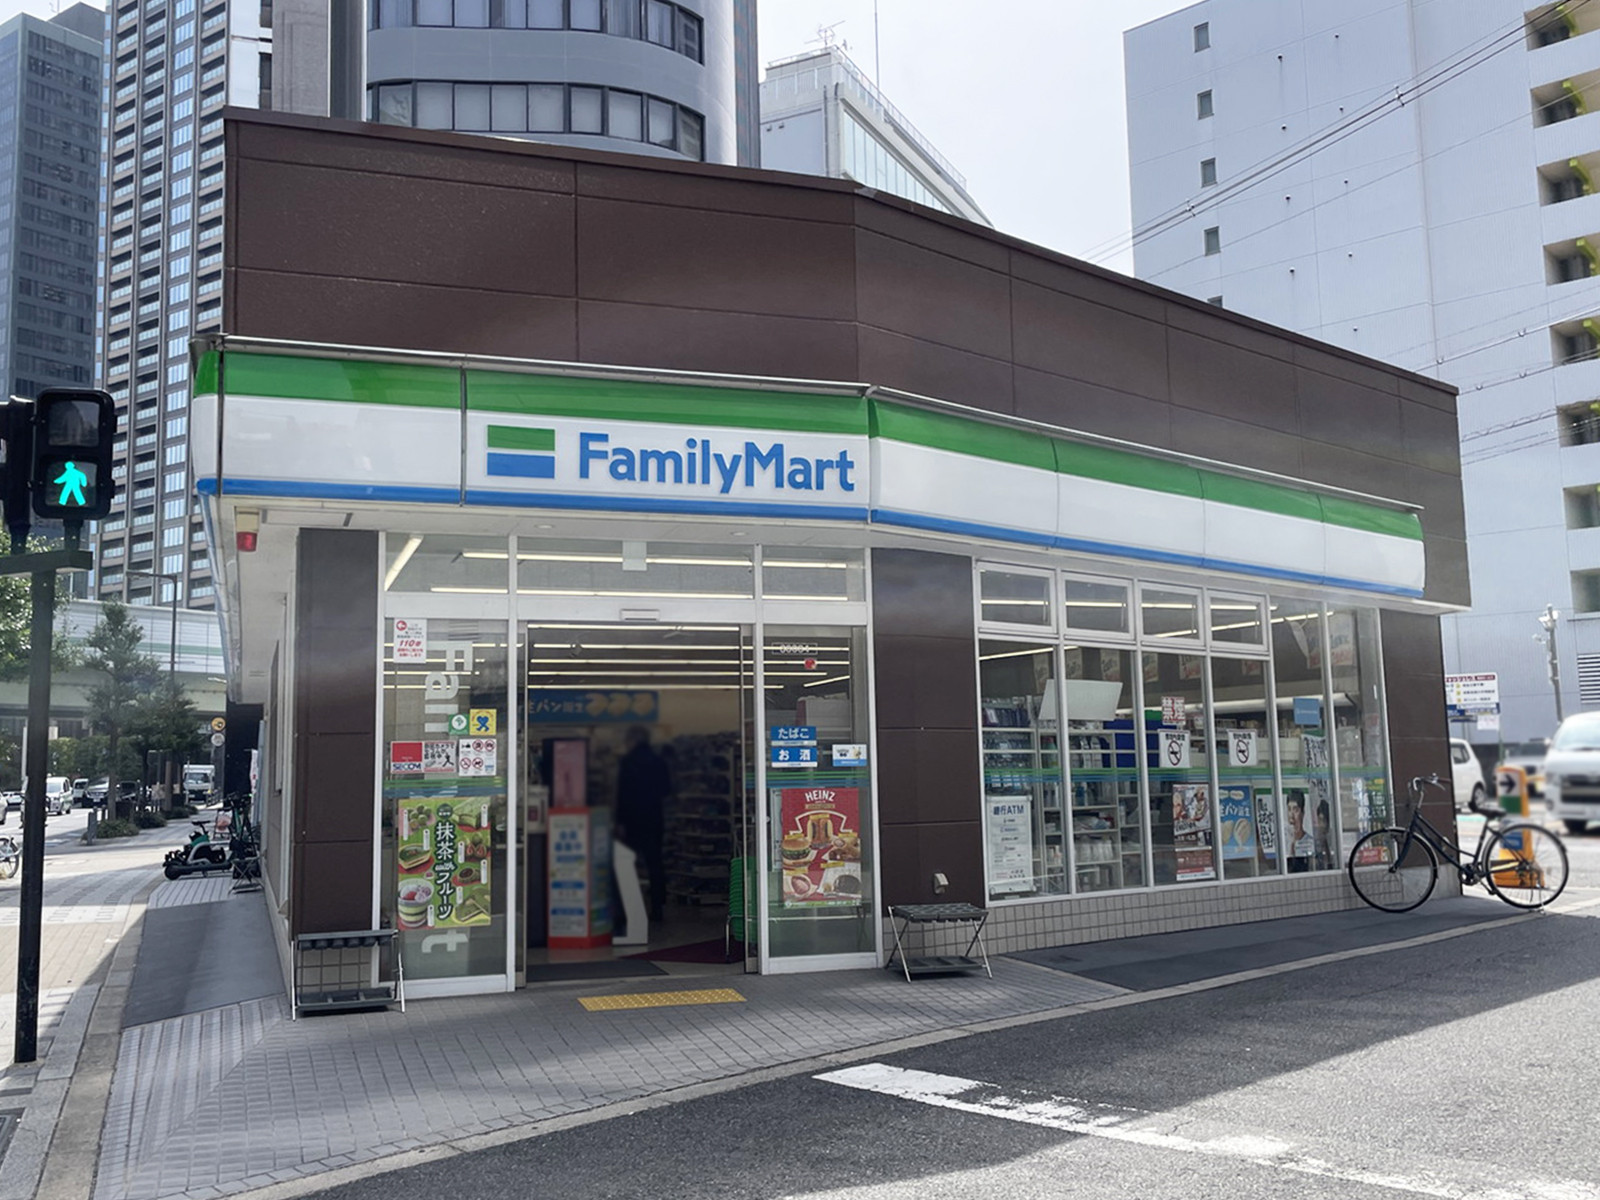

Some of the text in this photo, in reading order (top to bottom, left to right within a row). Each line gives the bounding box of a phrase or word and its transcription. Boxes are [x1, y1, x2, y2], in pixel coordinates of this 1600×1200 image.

[579, 432, 855, 494] FamilyMart
[778, 727, 810, 739] たばこ
[393, 763, 422, 771] SECOM
[804, 789, 836, 802] HEINZ
